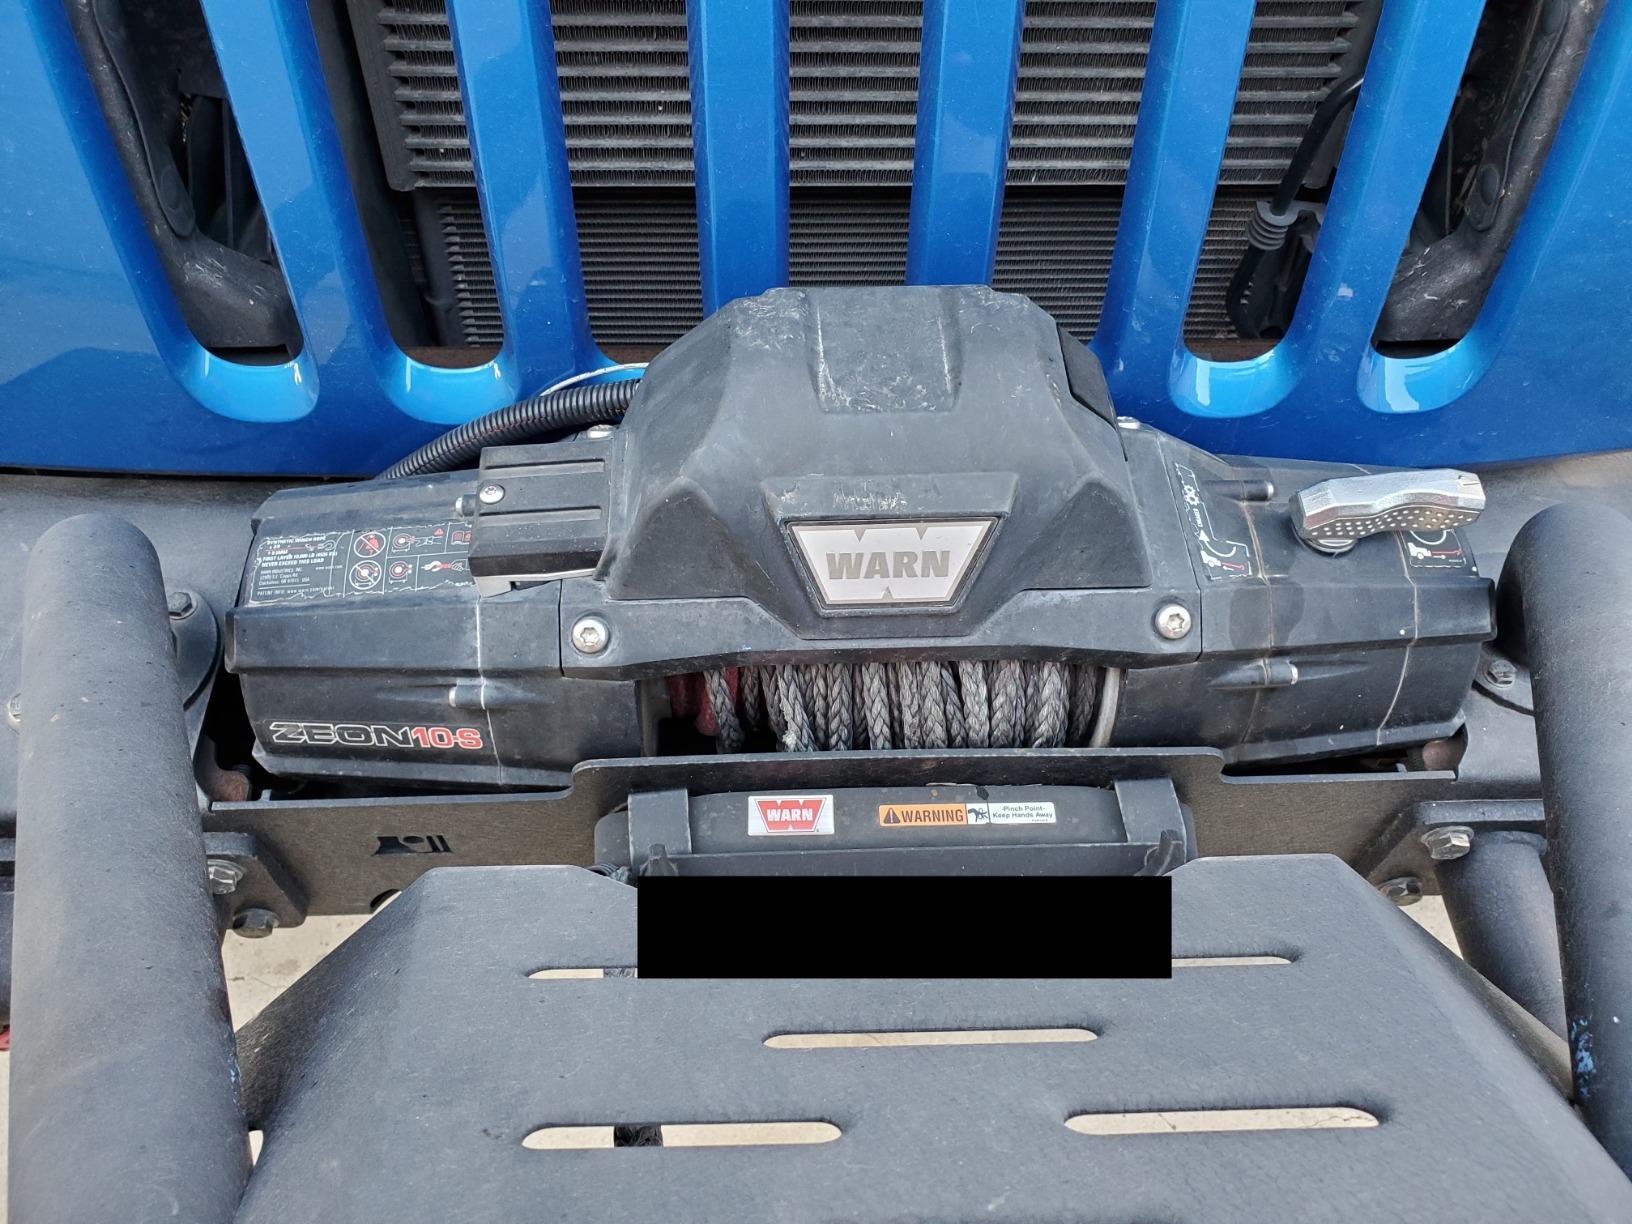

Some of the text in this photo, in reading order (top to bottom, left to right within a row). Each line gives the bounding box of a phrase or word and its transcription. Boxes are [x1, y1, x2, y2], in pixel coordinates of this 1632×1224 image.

[826, 550, 950, 580] WARN
[270, 722, 414, 748] ZEON
[766, 808, 813, 822] WARN
[902, 808, 964, 823] WARNING
